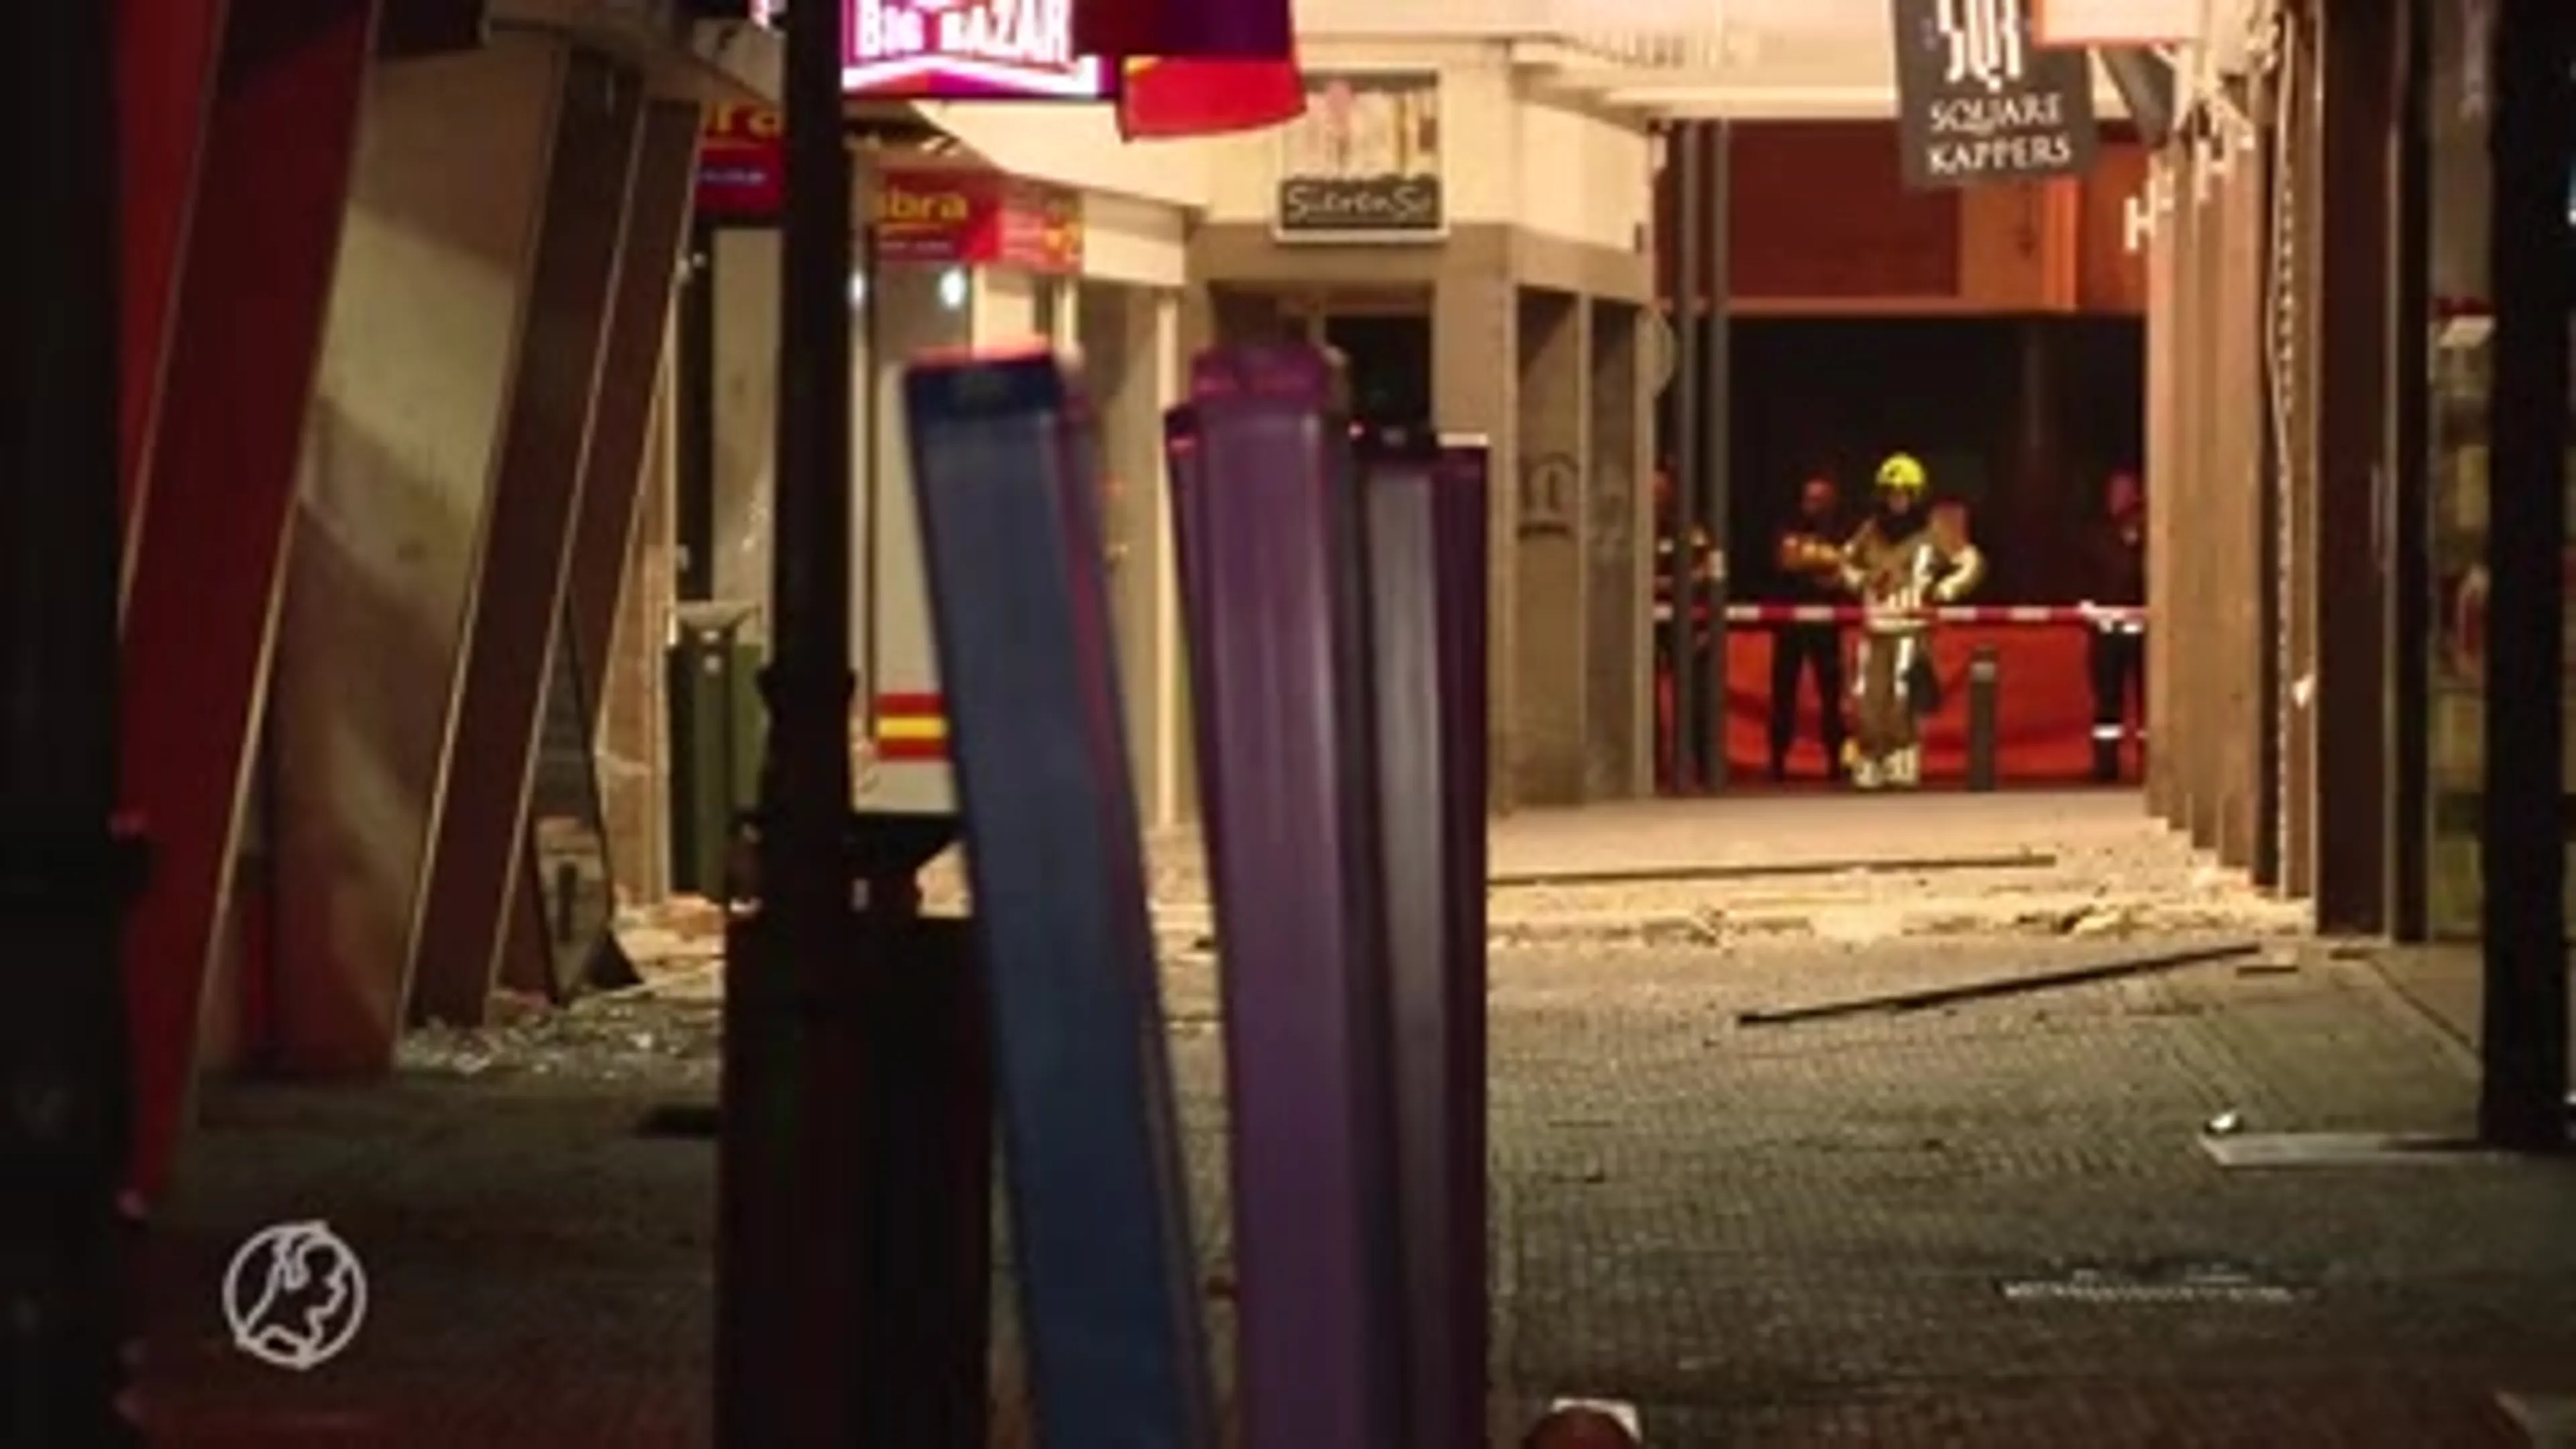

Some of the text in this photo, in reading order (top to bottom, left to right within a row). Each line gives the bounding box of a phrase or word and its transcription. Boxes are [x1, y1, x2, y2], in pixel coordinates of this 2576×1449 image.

[941, 0, 1069, 62] BAZAR
[1930, 92, 2063, 134] SQUARE
[1927, 133, 2072, 174] KAPPERS
